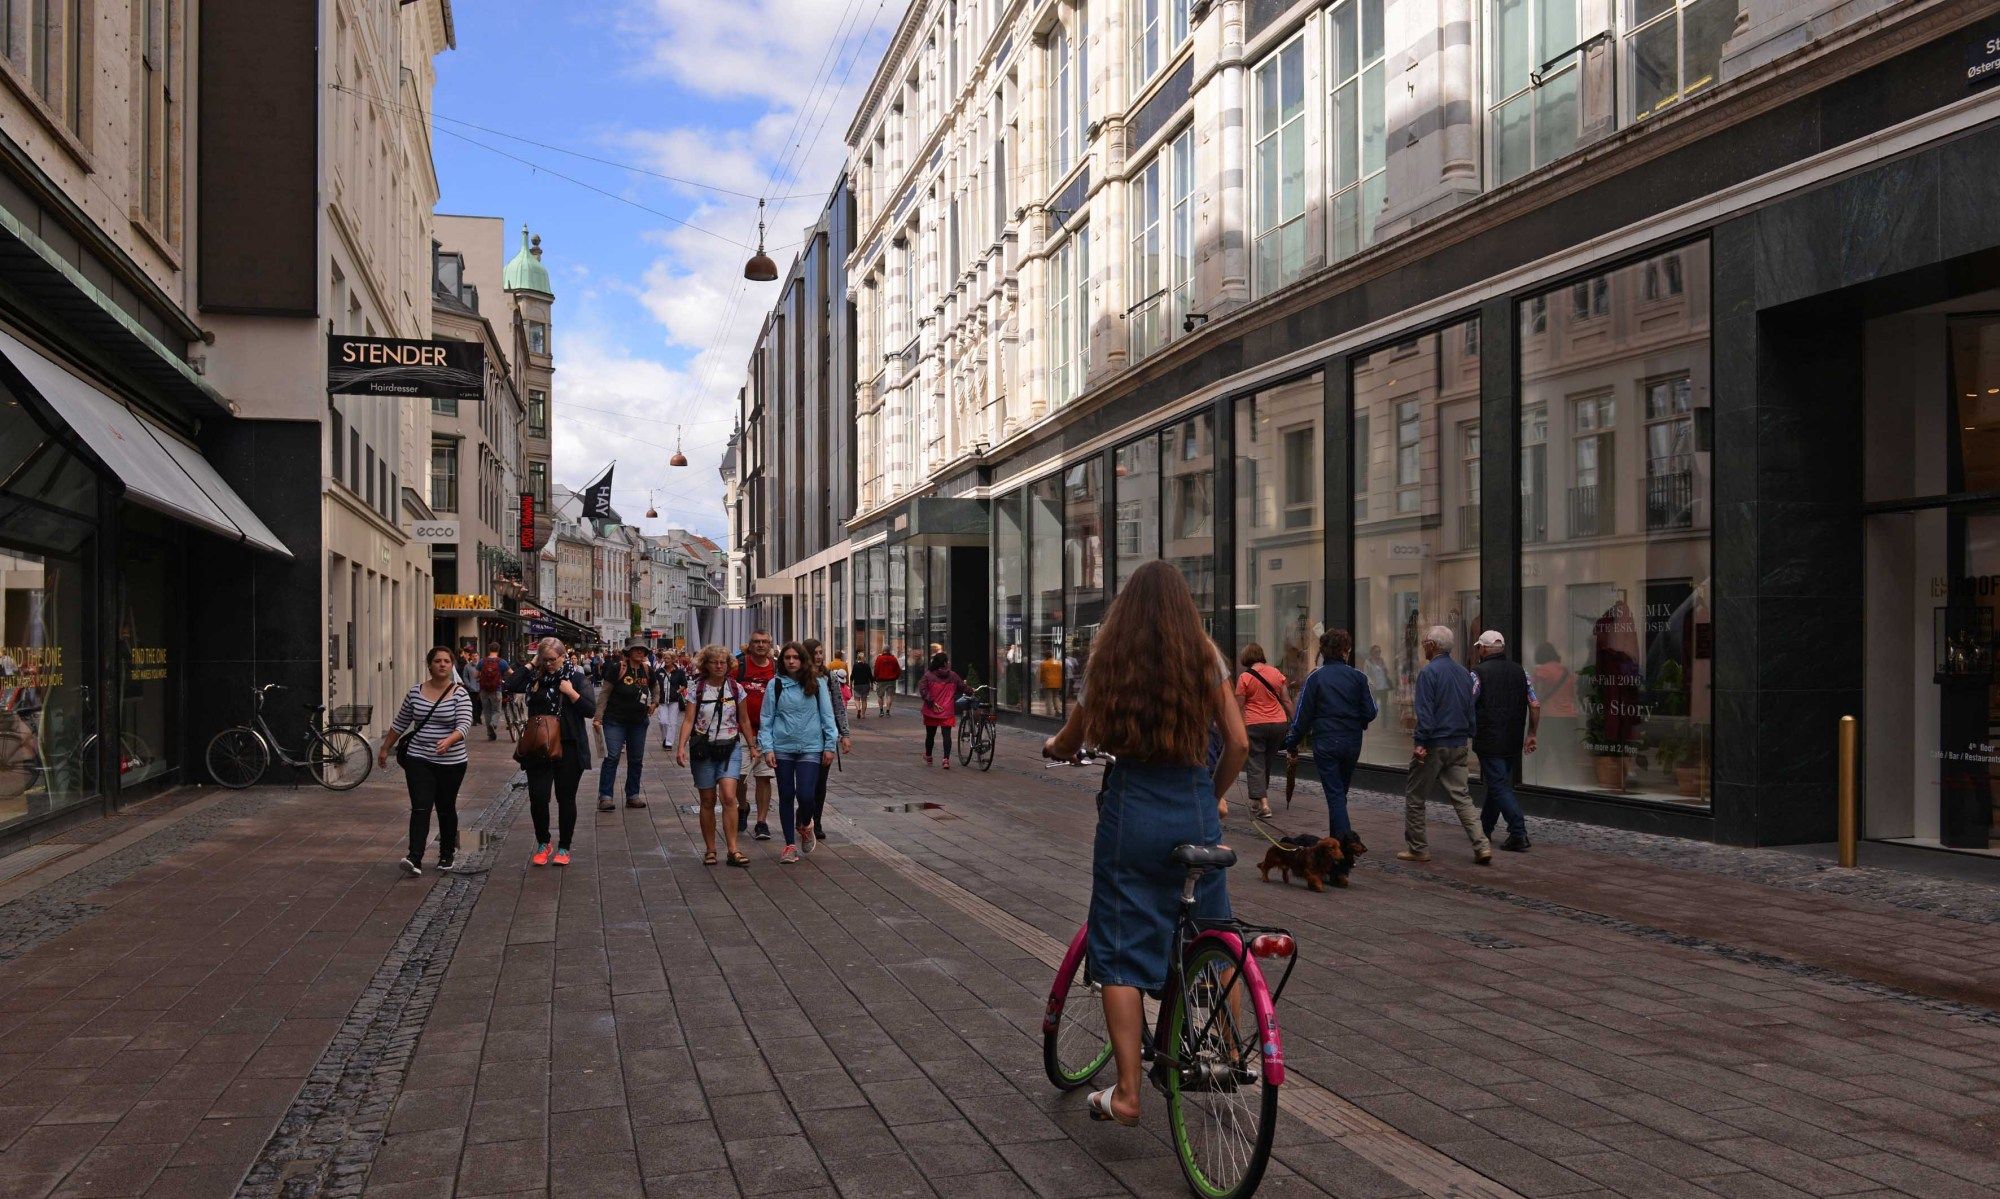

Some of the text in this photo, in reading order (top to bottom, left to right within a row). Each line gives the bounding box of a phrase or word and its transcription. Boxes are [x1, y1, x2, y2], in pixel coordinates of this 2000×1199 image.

[1986, 38, 2000, 54] St
[342, 342, 448, 367] STENDER
[370, 383, 418, 393] Hairdresser
[596, 486, 610, 516] HAY
[417, 527, 454, 537] ecco
[26, 647, 43, 667] THE
[45, 647, 62, 667] ONE
[1618, 675, 1641, 686] 2016
